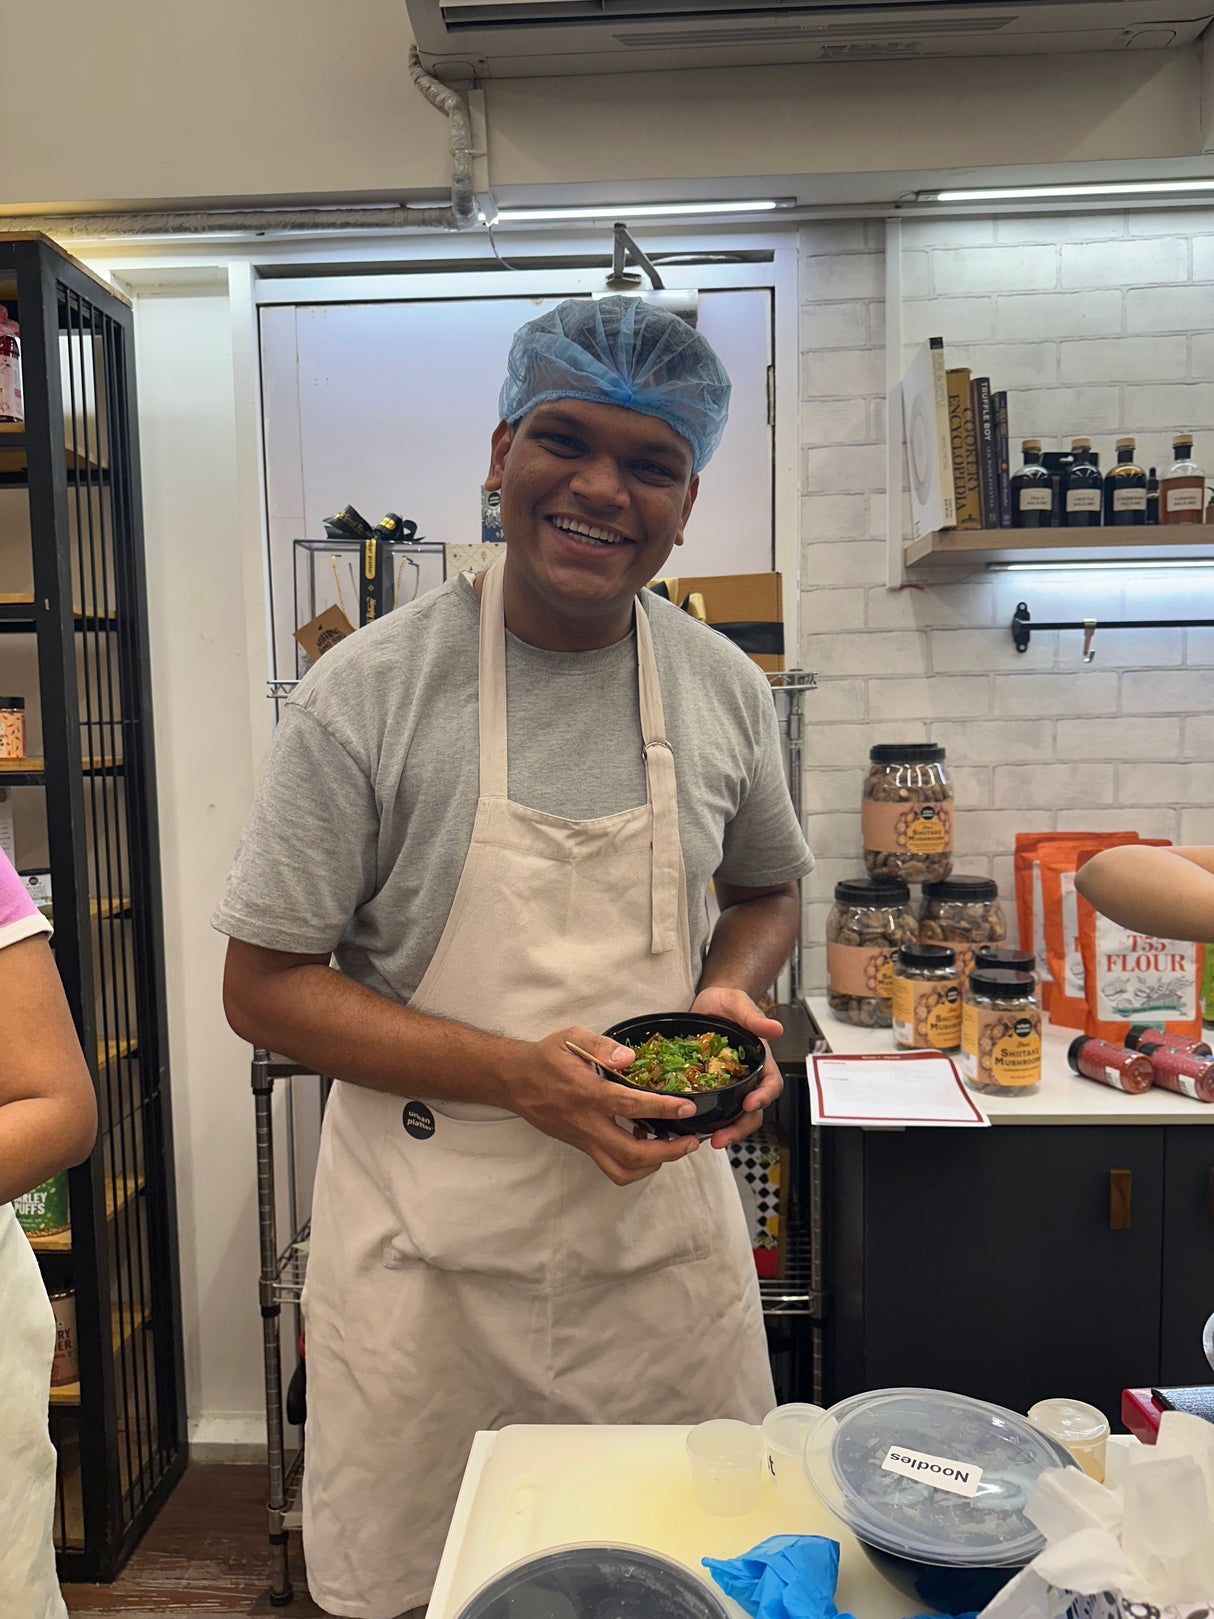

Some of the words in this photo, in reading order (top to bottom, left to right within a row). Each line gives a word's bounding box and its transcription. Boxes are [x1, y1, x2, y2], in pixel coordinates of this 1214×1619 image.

[981, 381, 990, 421] TRUFFLE
[983, 423, 991, 441] BOY
[948, 395, 967, 511] ENCYCLOPEDIA
[962, 408, 979, 491] COOKERY
[1127, 935, 1166, 952] T55
[1106, 954, 1187, 972] FLOUR
[995, 1056, 1041, 1067] MUSHROOM
[407, 1119, 433, 1130] platter
[408, 1111, 431, 1124] urban
[13, 1192, 47, 1204] ARLEY
[14, 1203, 45, 1215] PUFFS
[889, 1452, 970, 1483] Noodles
